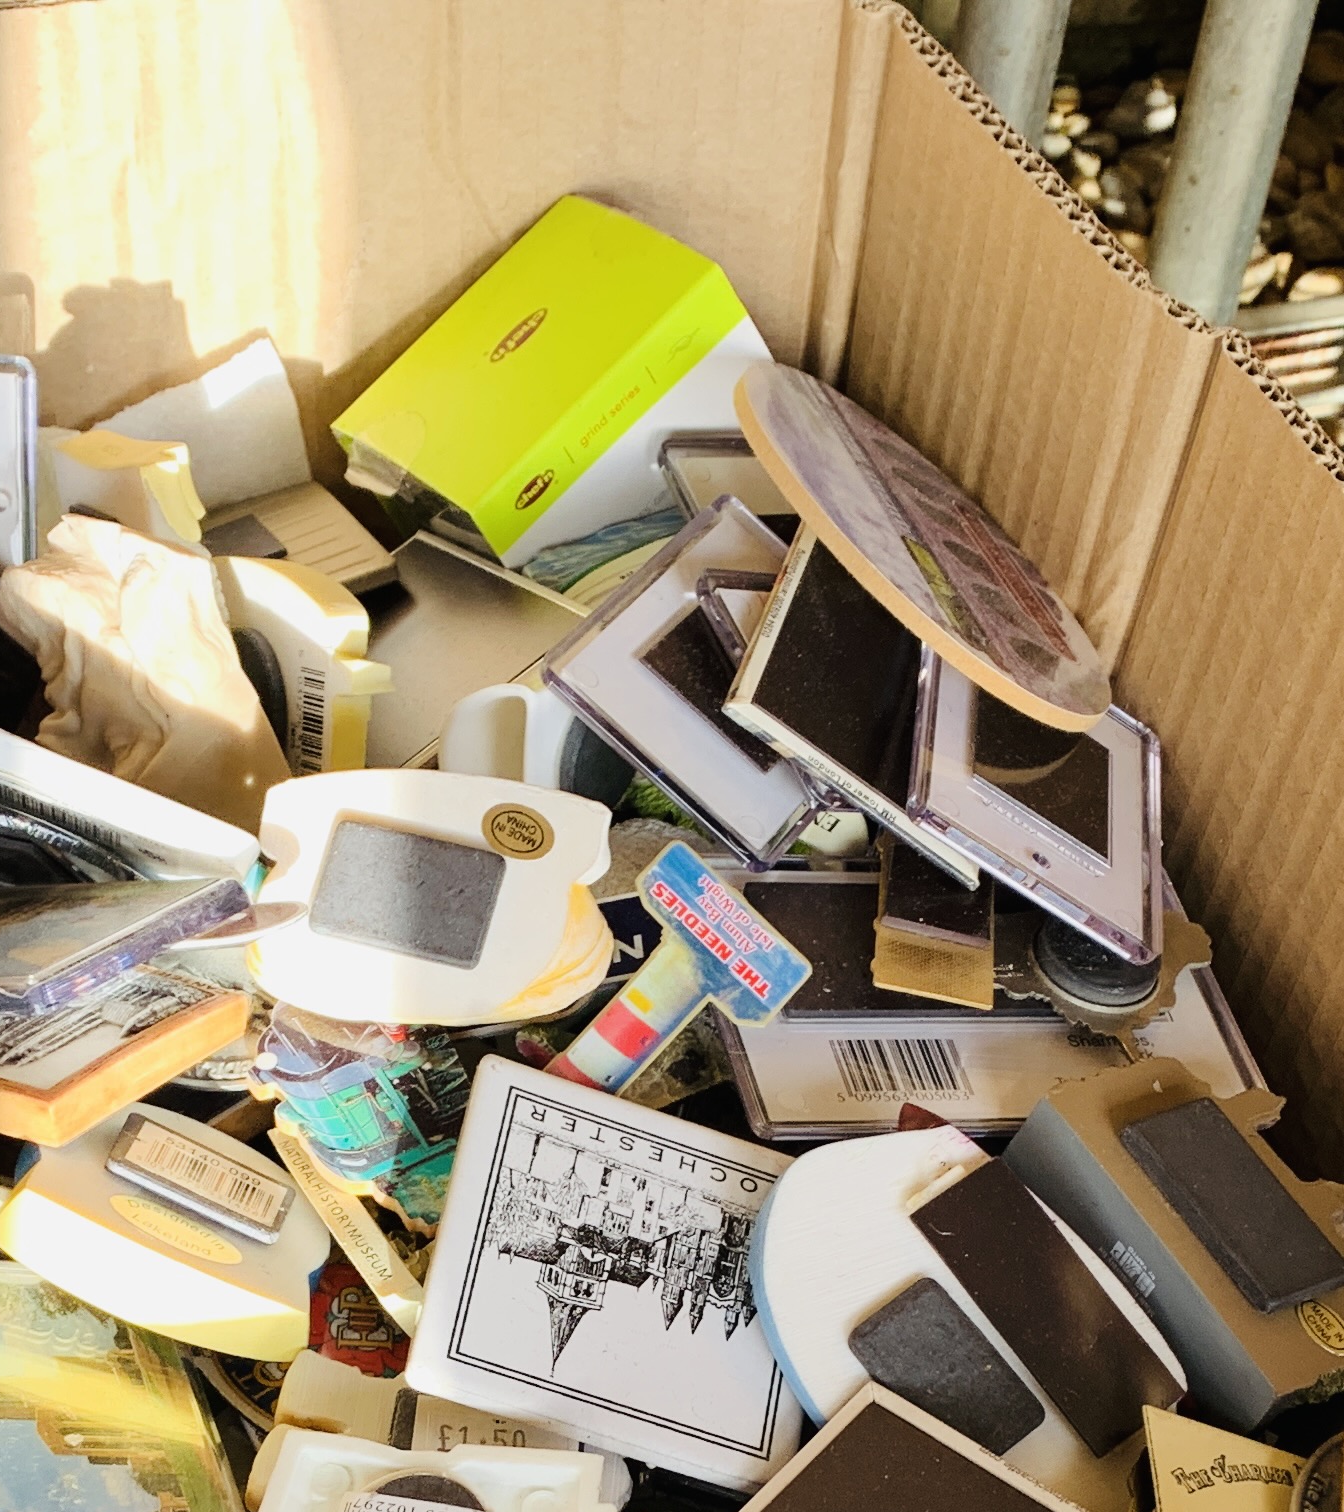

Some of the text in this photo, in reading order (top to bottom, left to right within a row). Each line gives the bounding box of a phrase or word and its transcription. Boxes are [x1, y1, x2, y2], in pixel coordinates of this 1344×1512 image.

[579, 383, 643, 448] grind series
[807, 755, 841, 785] London
[853, 787, 881, 813] Tower
[493, 820, 538, 849] MADE IN
[505, 814, 538, 836] CHINA
[696, 872, 739, 916] Wight
[648, 877, 775, 1001] THE NEEDLES
[692, 893, 757, 958] Alum Bay
[745, 922, 776, 953] Isle
[162, 1136, 262, 1188] 53140-099
[530, 1104, 759, 1194] OCHESTER
[125, 1195, 228, 1254] Designed in
[129, 1210, 214, 1261] Lakeland
[1307, 1314, 1334, 1343] CHINA
[1310, 1303, 1334, 1332] MADE
[1170, 1465, 1213, 1494] THE
